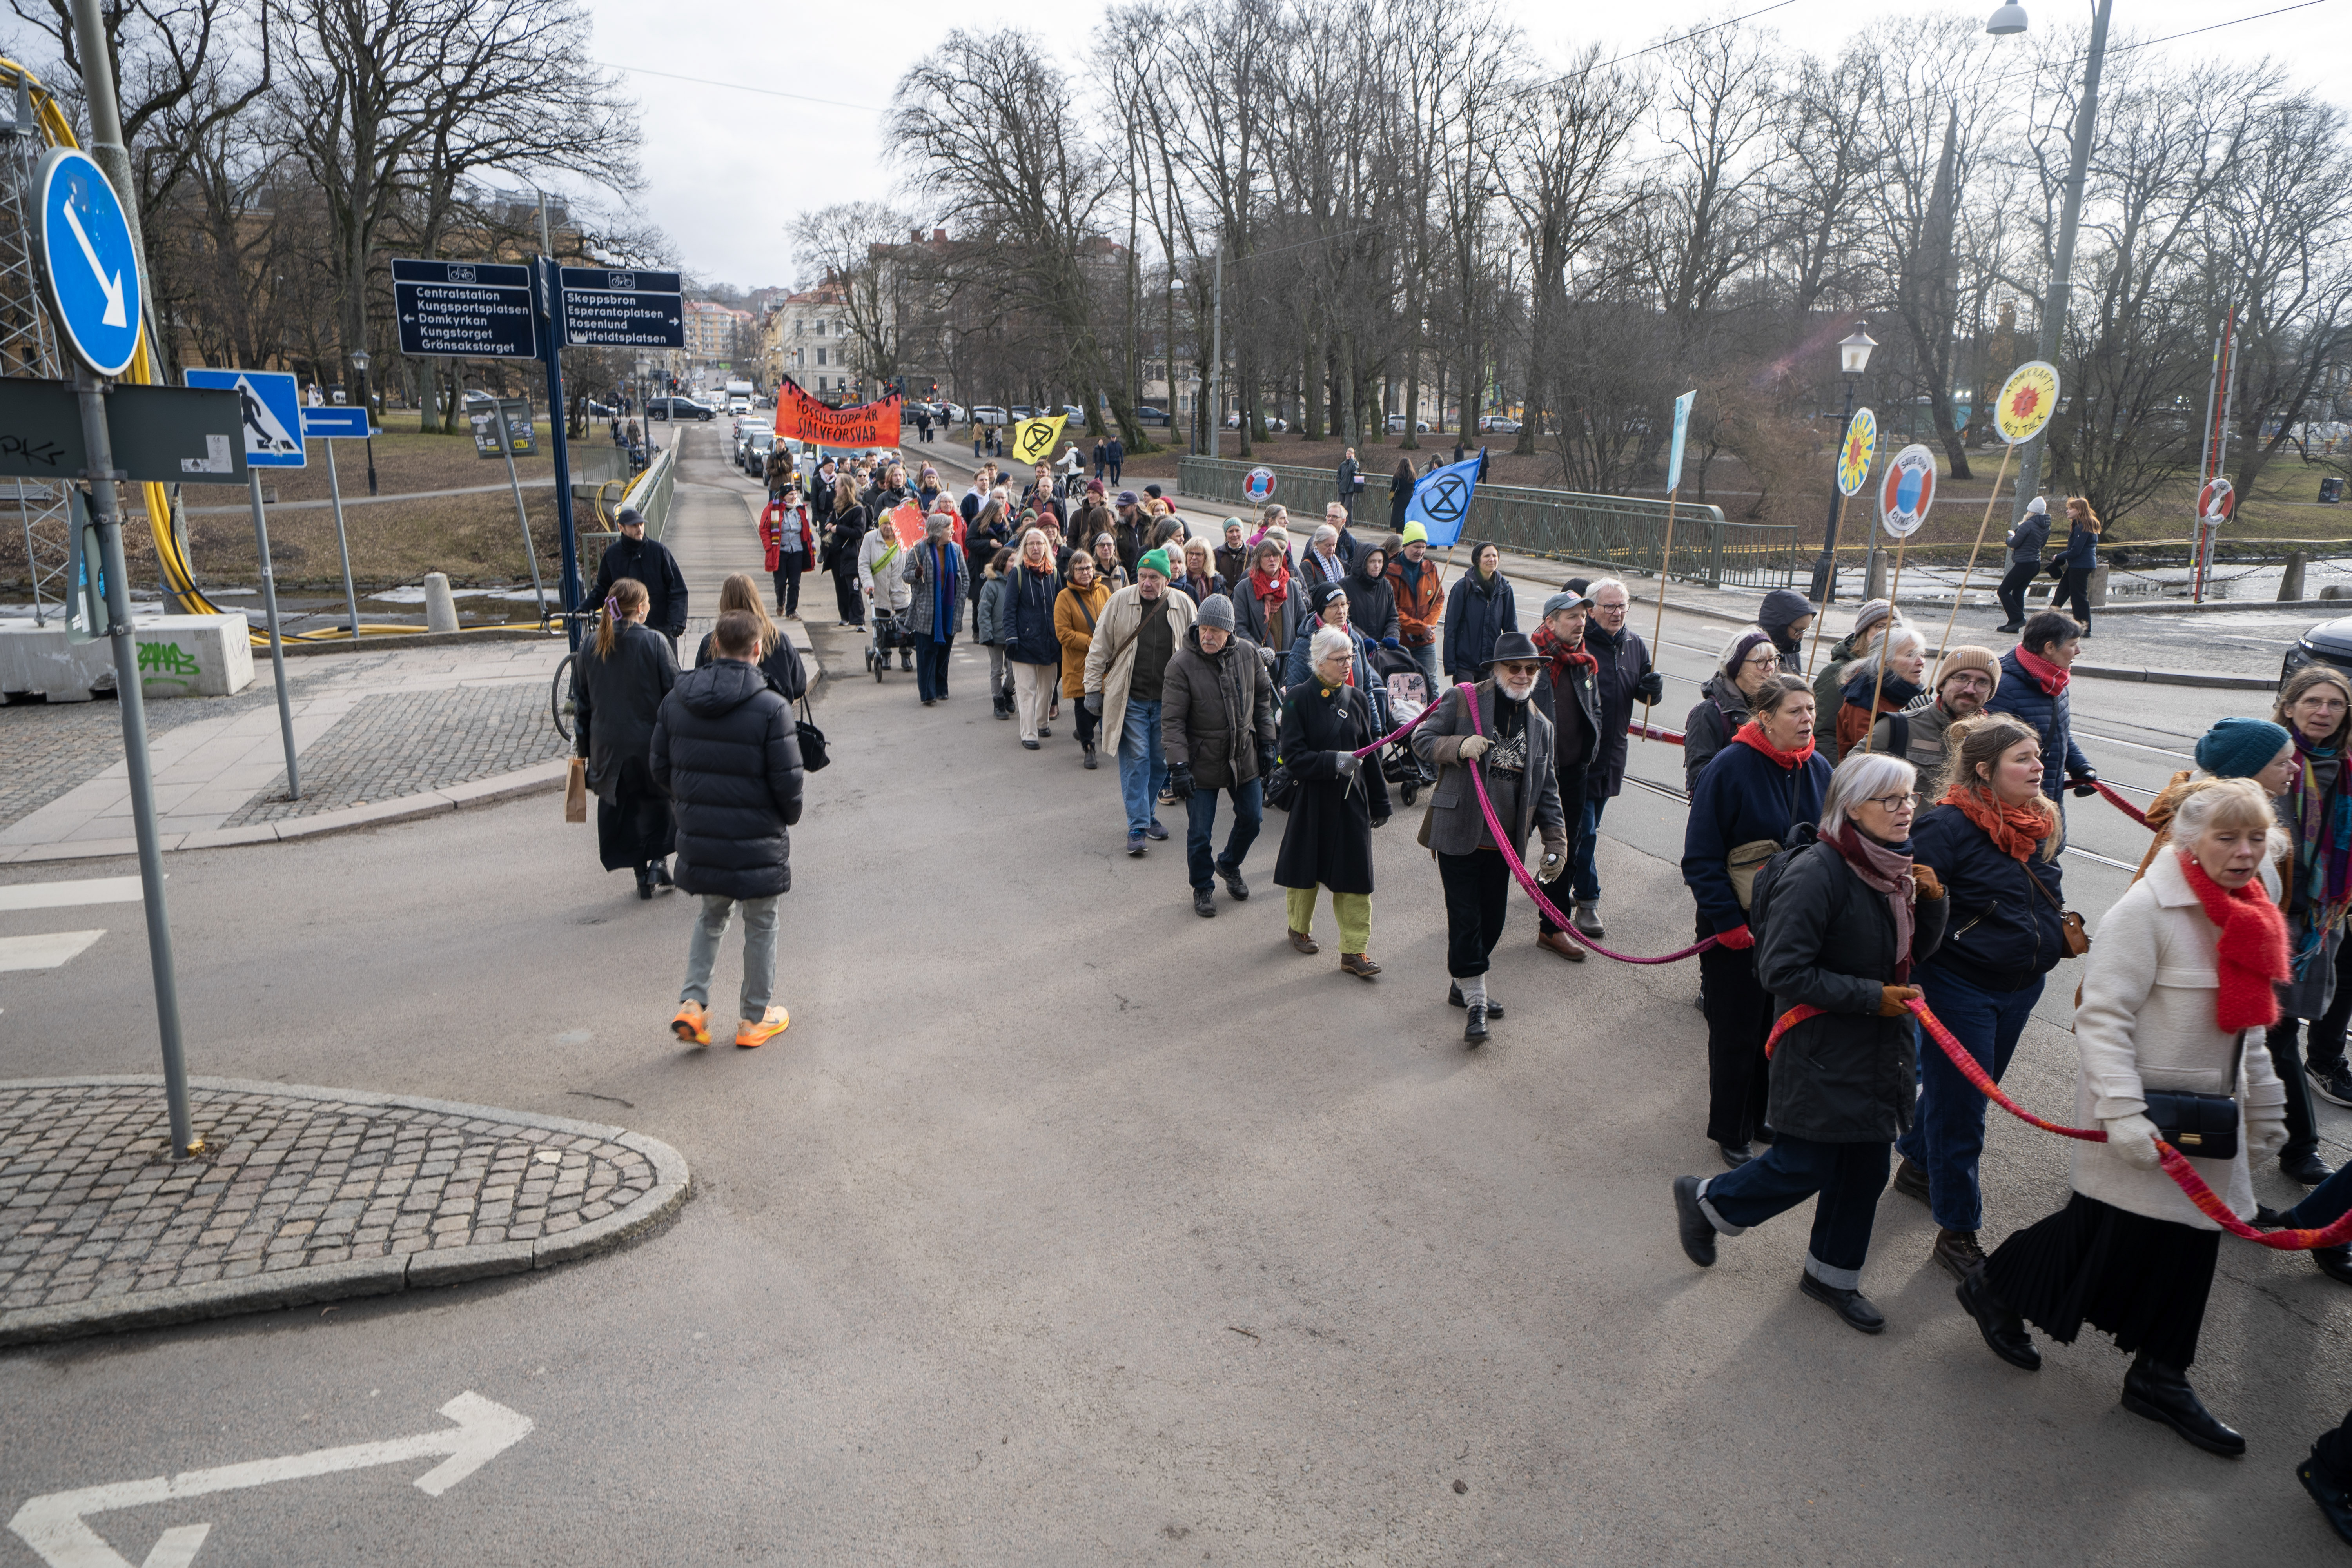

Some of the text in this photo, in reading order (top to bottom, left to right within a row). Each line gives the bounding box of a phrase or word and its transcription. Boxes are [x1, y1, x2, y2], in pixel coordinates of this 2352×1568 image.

[416, 287, 500, 301] Centralstation
[568, 292, 636, 306] Skeppsbron
[417, 299, 529, 315] Kungsportsplatsen
[568, 305, 663, 319] Esperantoplatsen
[419, 313, 487, 327] Domkyrkan
[569, 318, 628, 330] Rosenlund
[420, 326, 492, 340] Kungstorget
[422, 339, 515, 354] Grönsakstorget
[2005, 367, 2055, 396] ATOMKRAFT?
[797, 399, 878, 425] FOSSILSTOPP ÄR
[796, 417, 876, 442] SJÄLVFÖRSVAR
[2003, 412, 2045, 436] NEJ TACK
[1901, 456, 1918, 470] SAVE
[1891, 510, 1915, 526] CLIMATE
